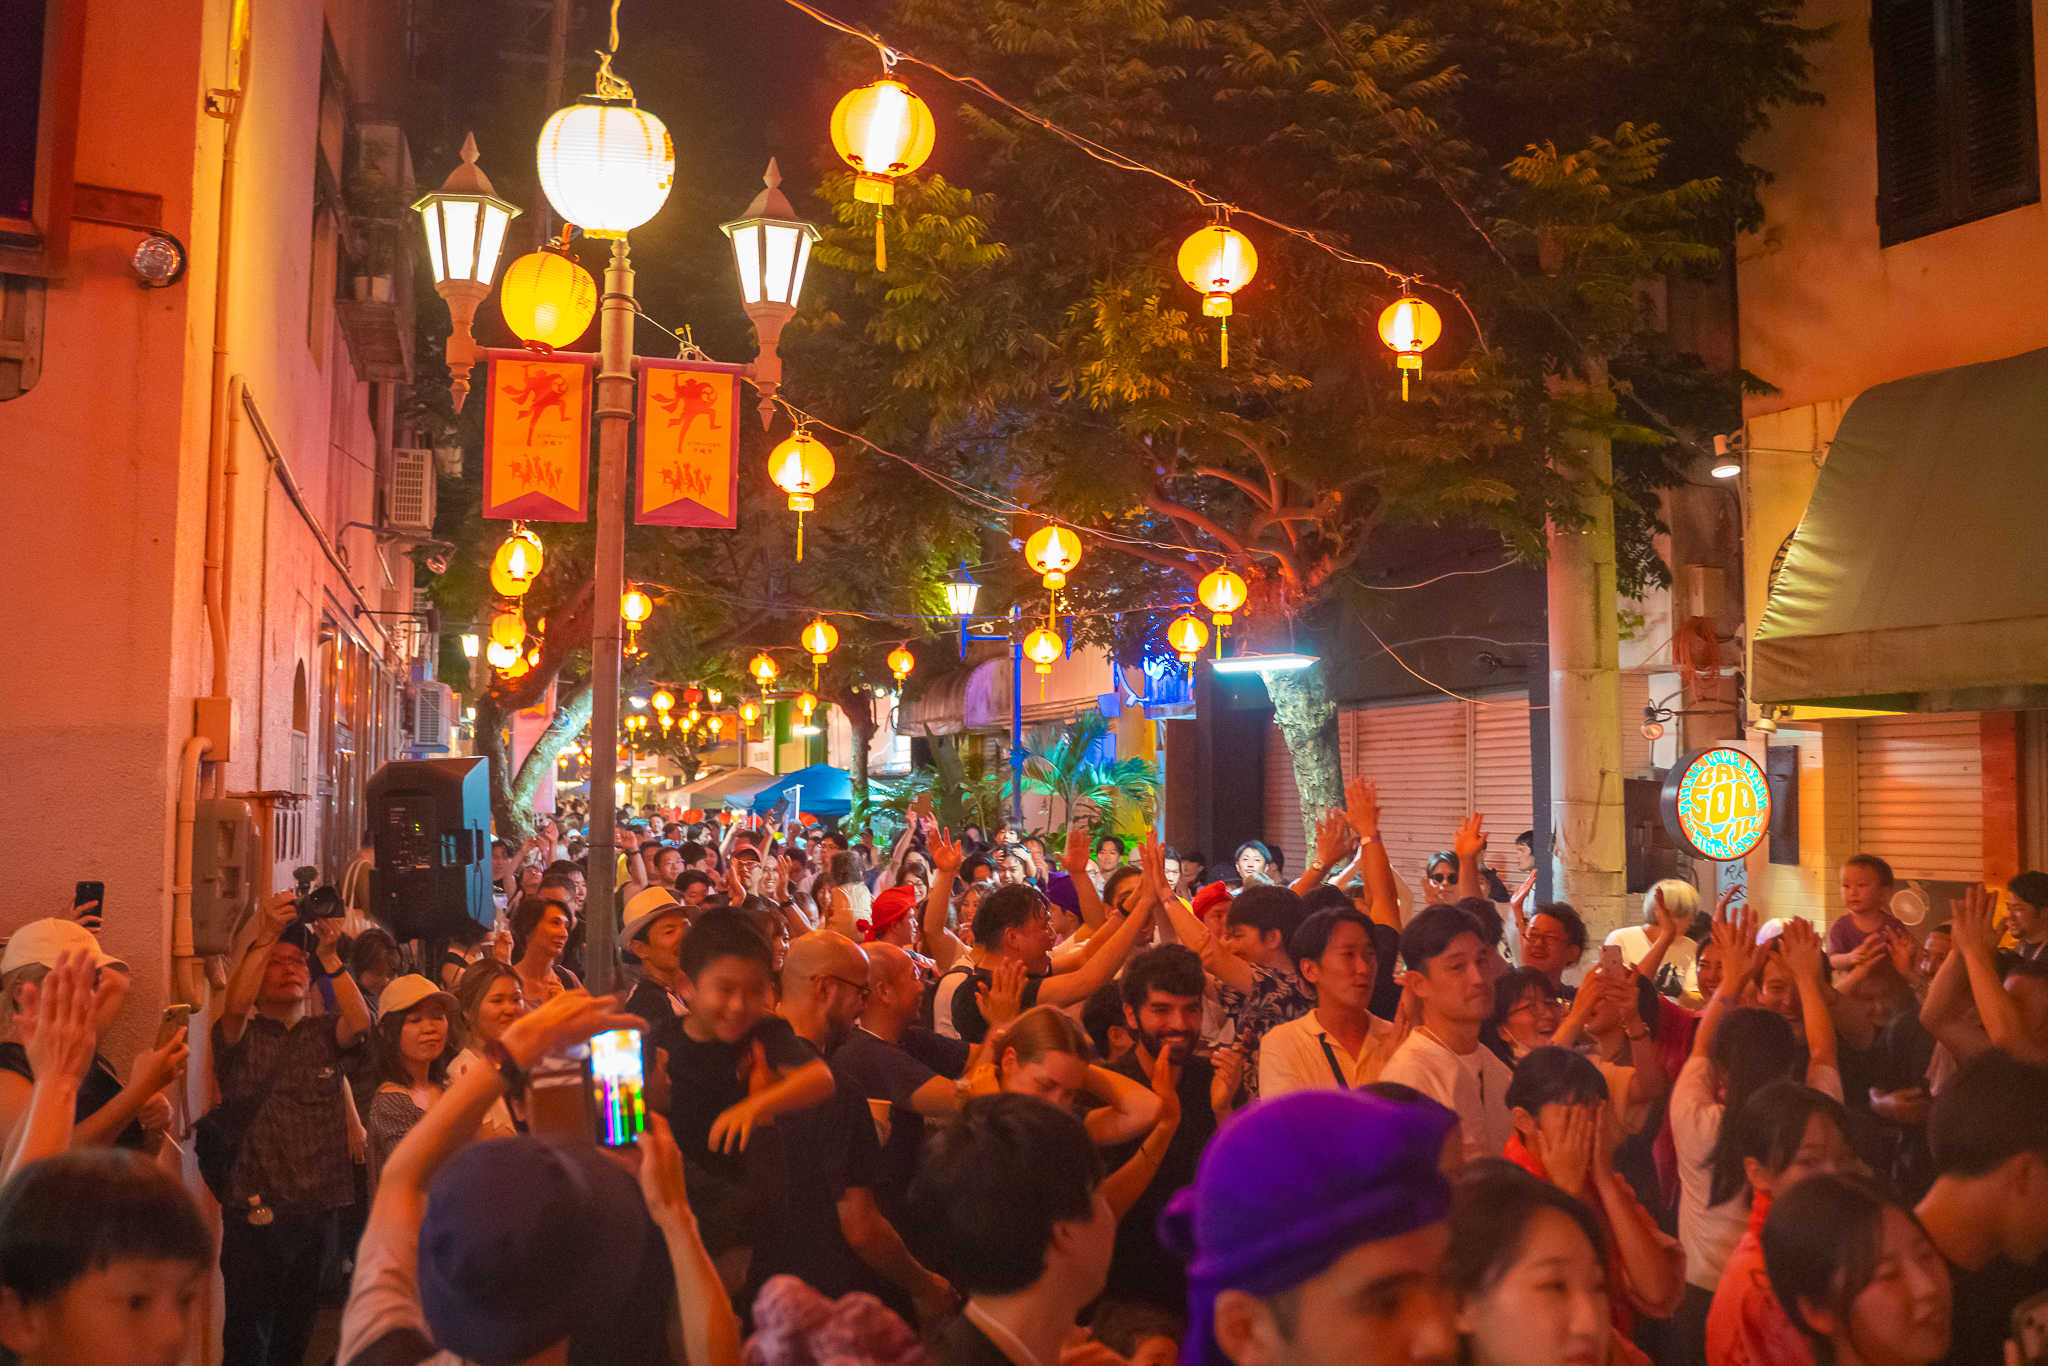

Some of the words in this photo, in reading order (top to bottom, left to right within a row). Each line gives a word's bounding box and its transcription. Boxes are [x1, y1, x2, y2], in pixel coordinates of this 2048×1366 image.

[1679, 763, 1704, 816] MUSIC
[1704, 750, 1740, 767] LOVE
[1694, 763, 1754, 787] BAR
[1690, 782, 1757, 824] 500
[1692, 829, 1732, 857] SINCE
